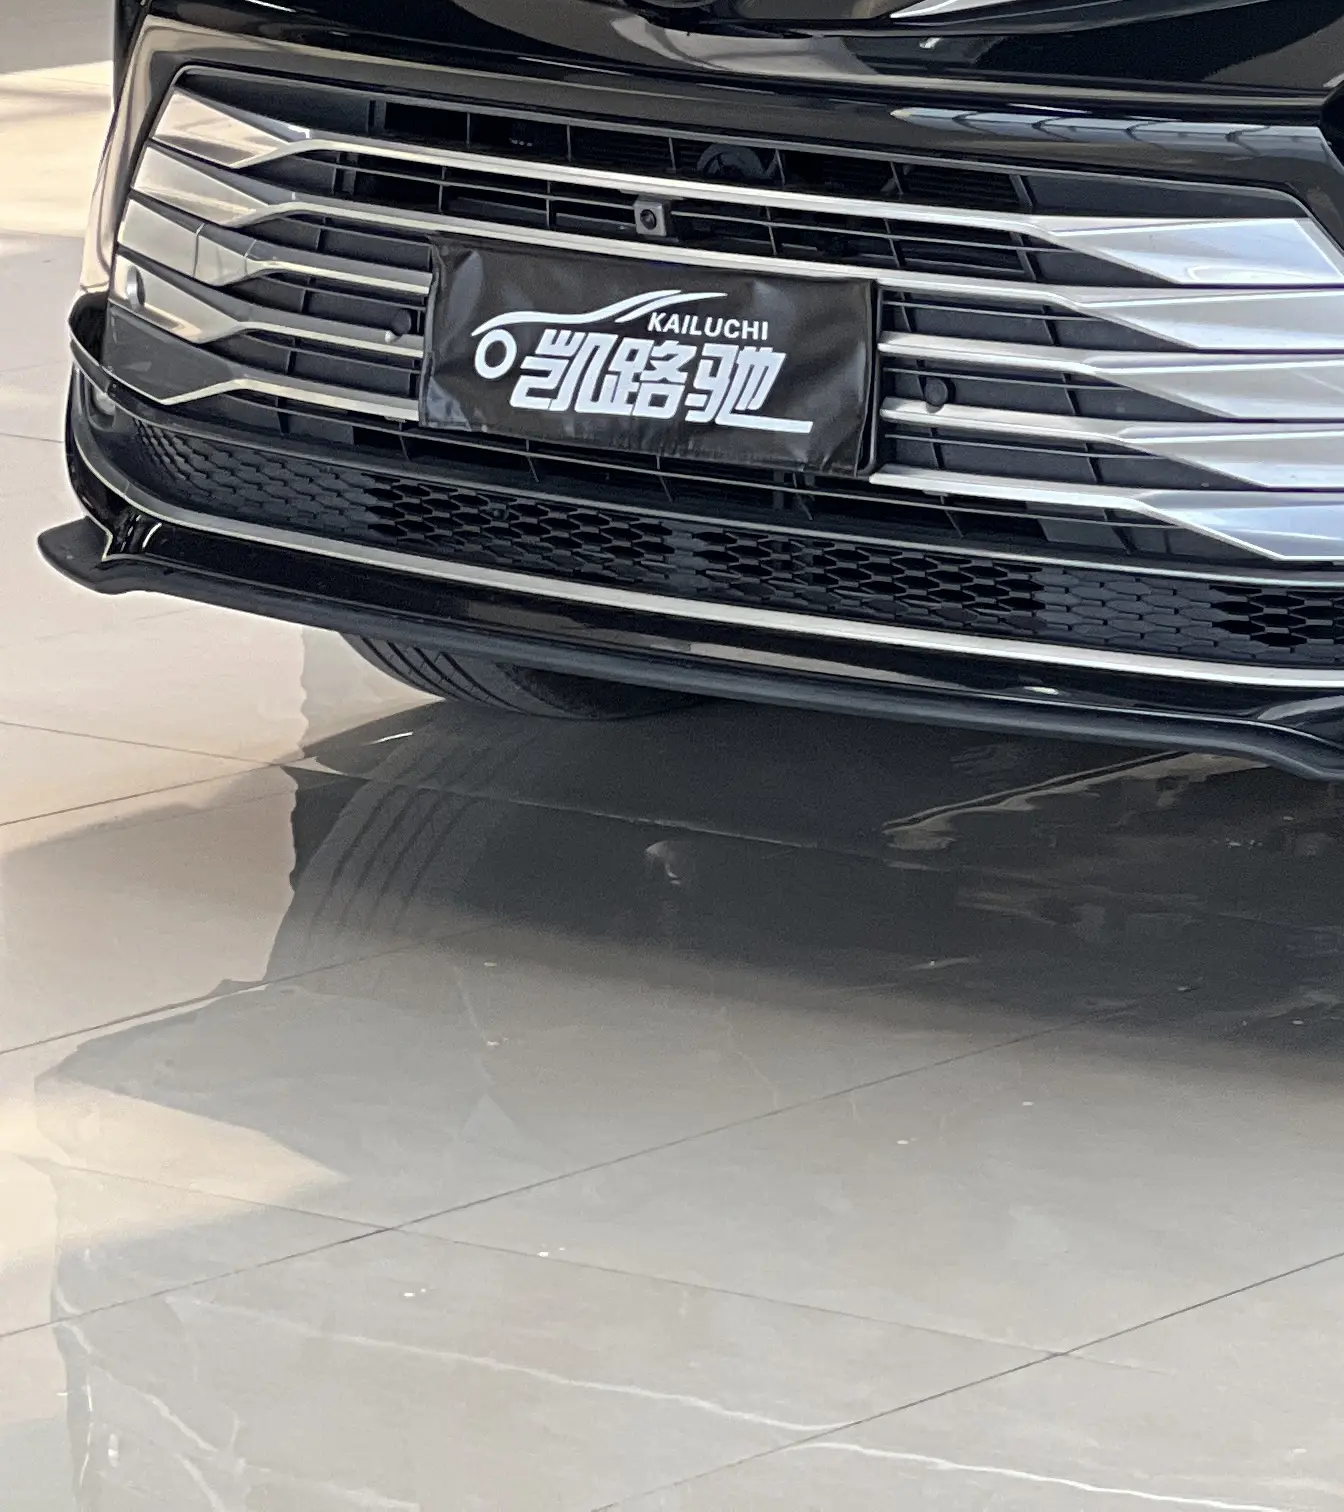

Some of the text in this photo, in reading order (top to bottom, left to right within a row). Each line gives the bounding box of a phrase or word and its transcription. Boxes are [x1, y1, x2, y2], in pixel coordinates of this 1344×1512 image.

[648, 311, 769, 342] KAILUCHI
[509, 328, 813, 434] 凯路驰
